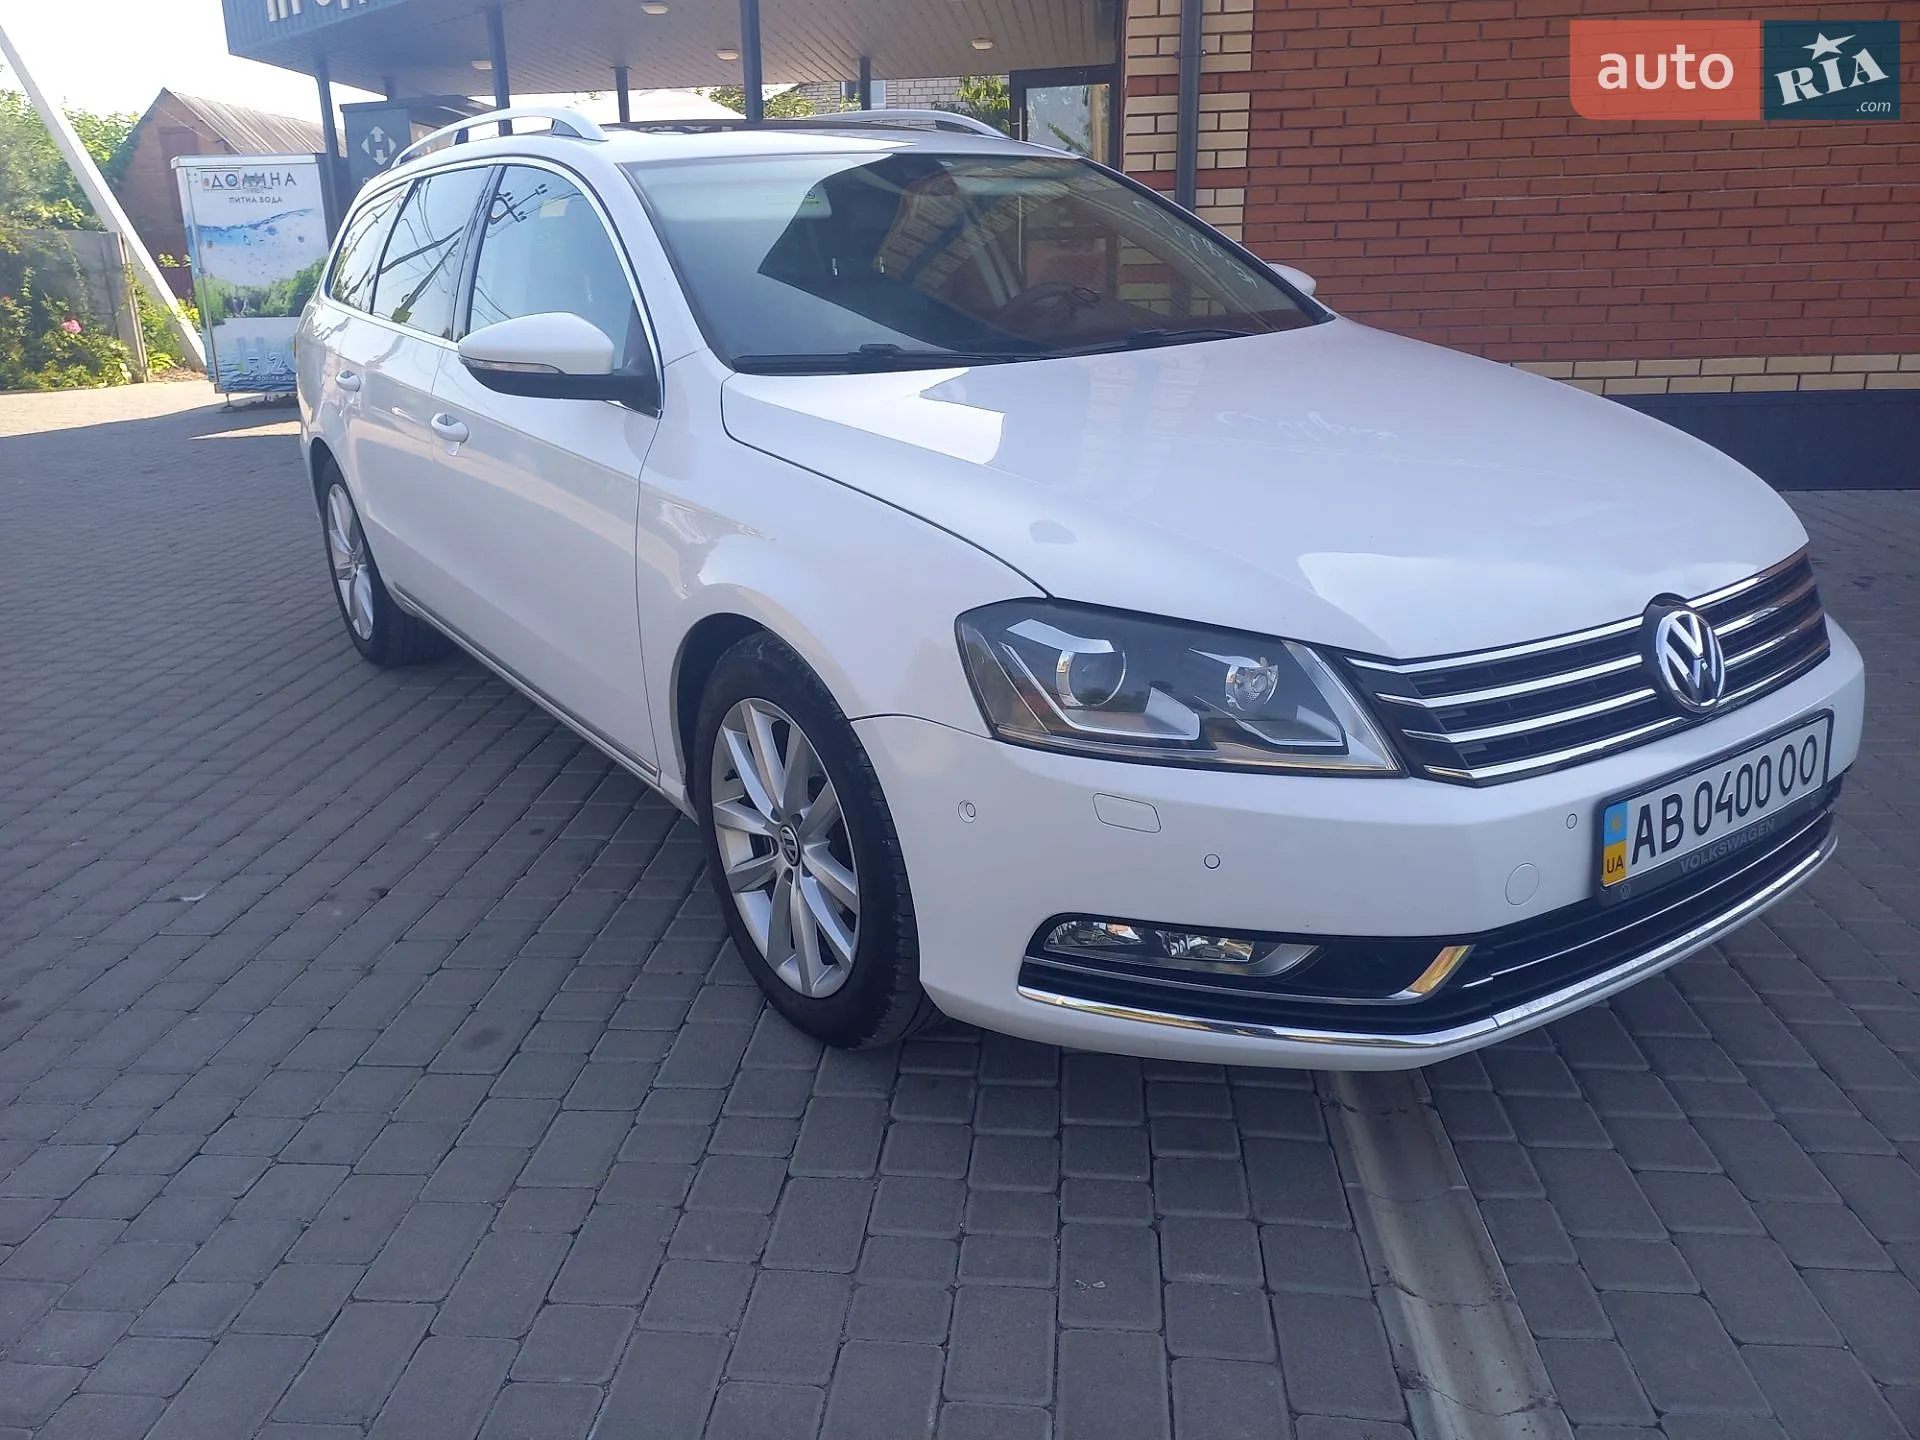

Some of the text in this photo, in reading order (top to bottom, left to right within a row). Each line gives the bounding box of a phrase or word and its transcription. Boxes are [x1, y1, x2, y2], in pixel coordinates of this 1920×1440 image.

[211, 172, 297, 189] ДОЛИНА
[260, 196, 283, 204] ВОДА
[1631, 793, 1685, 865] AB
[1693, 755, 1772, 836] 0400
[1679, 818, 1775, 873] VOLKSWAGEN
[1606, 856, 1624, 874] UA
